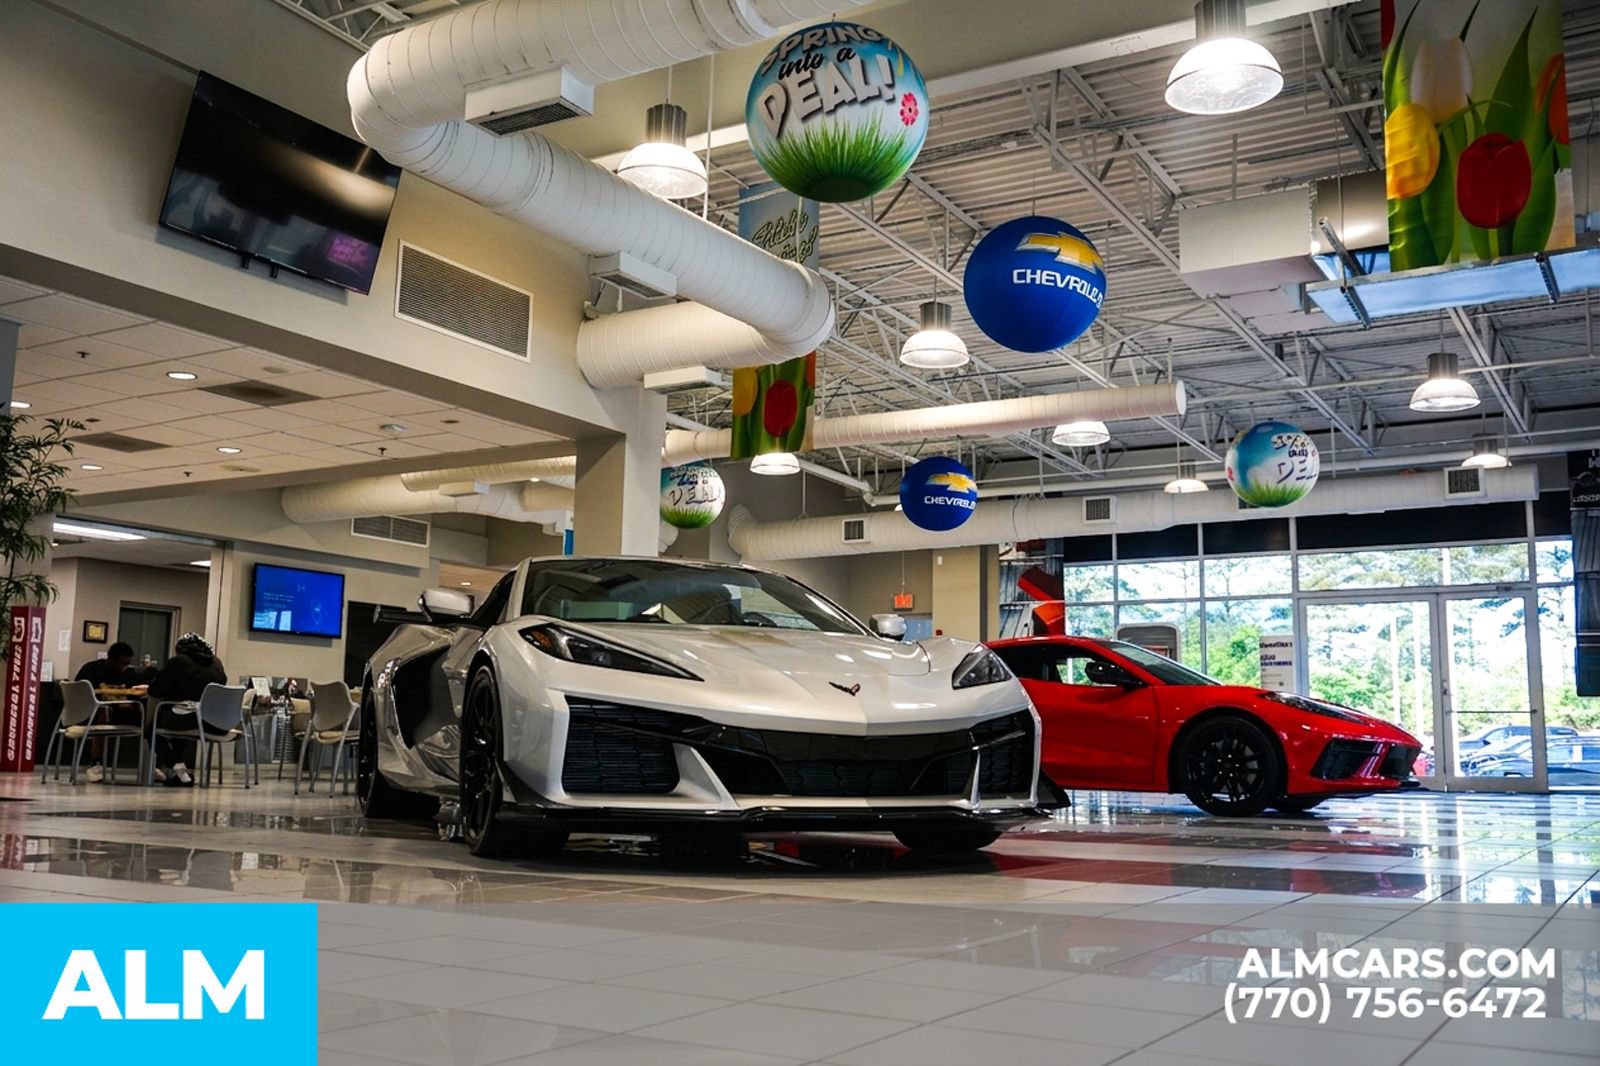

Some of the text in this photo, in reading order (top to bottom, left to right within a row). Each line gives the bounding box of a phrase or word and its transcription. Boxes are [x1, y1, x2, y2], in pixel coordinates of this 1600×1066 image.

[778, 47, 857, 81] into a
[757, 54, 896, 139] DEAL!
